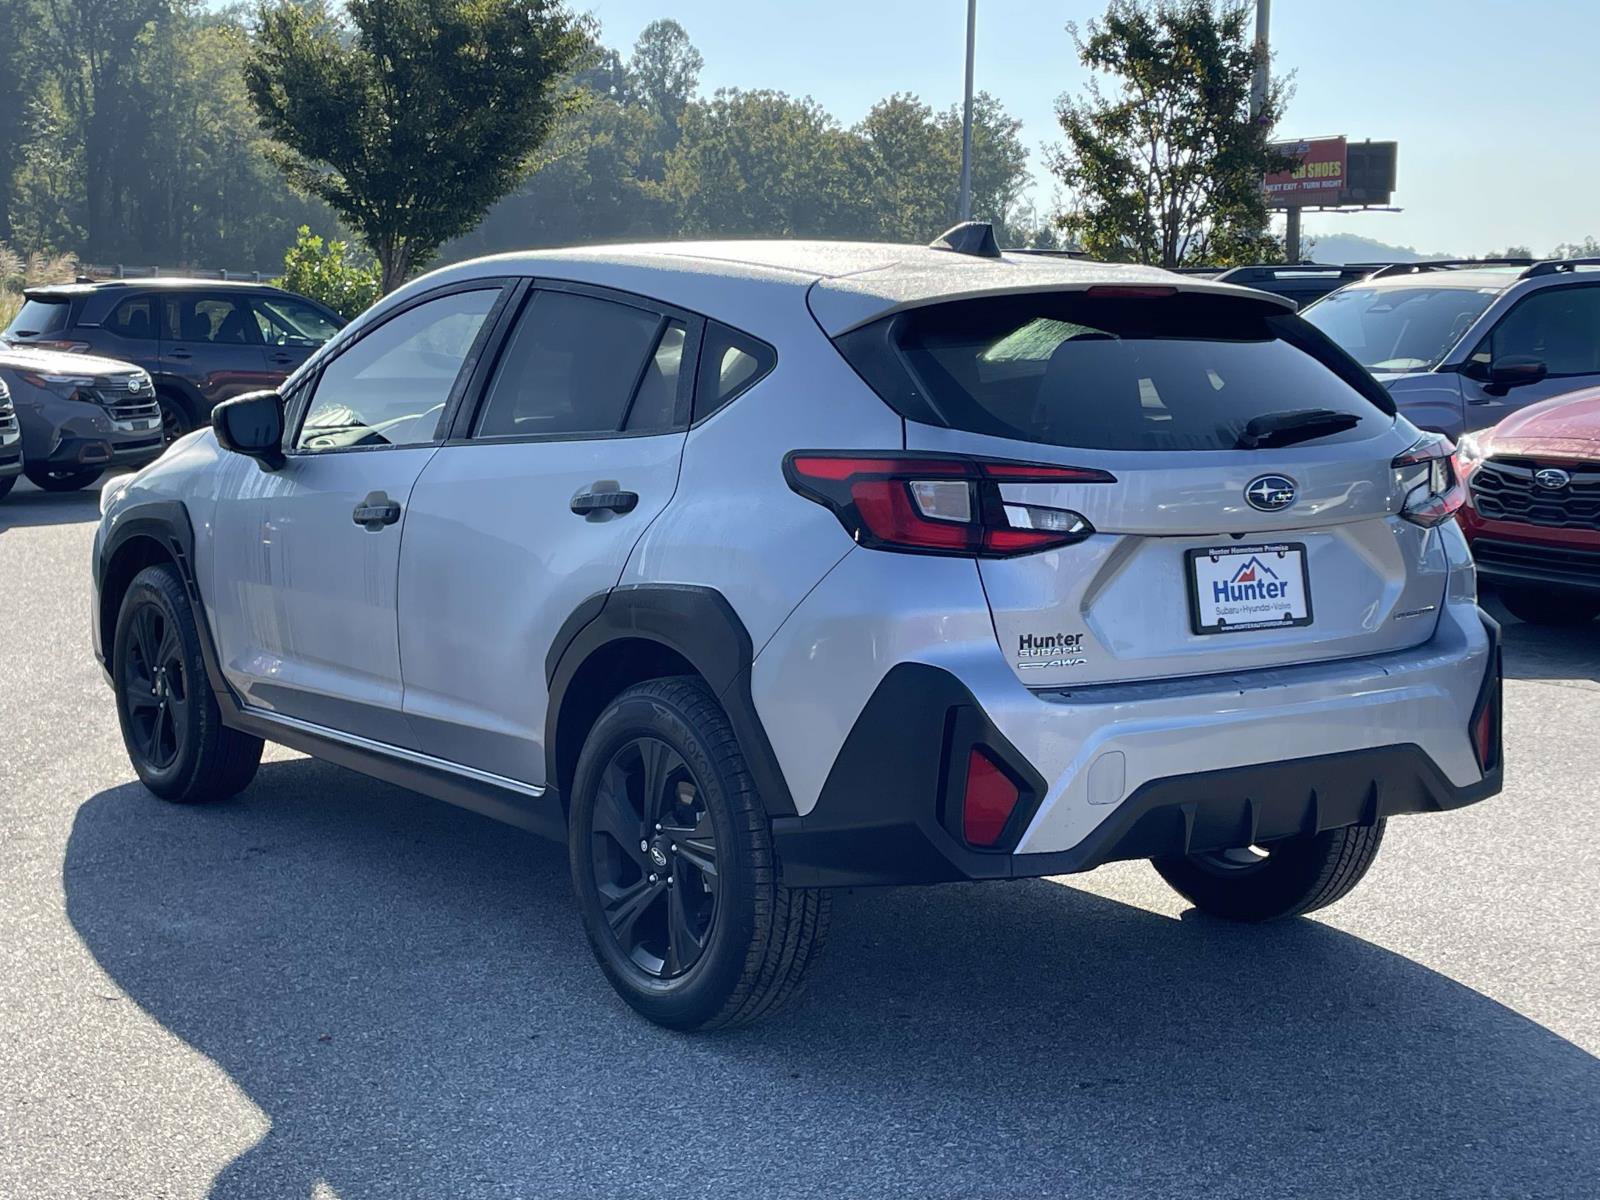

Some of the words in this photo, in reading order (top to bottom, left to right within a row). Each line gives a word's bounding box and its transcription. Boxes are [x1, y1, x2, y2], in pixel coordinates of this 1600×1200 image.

[1308, 162, 1341, 177] SHOES
[1284, 182, 1297, 190] EXIT
[1303, 181, 1320, 189] TURN
[1321, 180, 1342, 188] RIGHT
[1208, 548, 1230, 556] Hunter
[1231, 546, 1263, 555] Hometown
[1264, 544, 1289, 552] Promise
[1213, 578, 1288, 603] Hunter
[1020, 633, 1083, 650] Hunter
[1019, 646, 1083, 656] SUBARU
